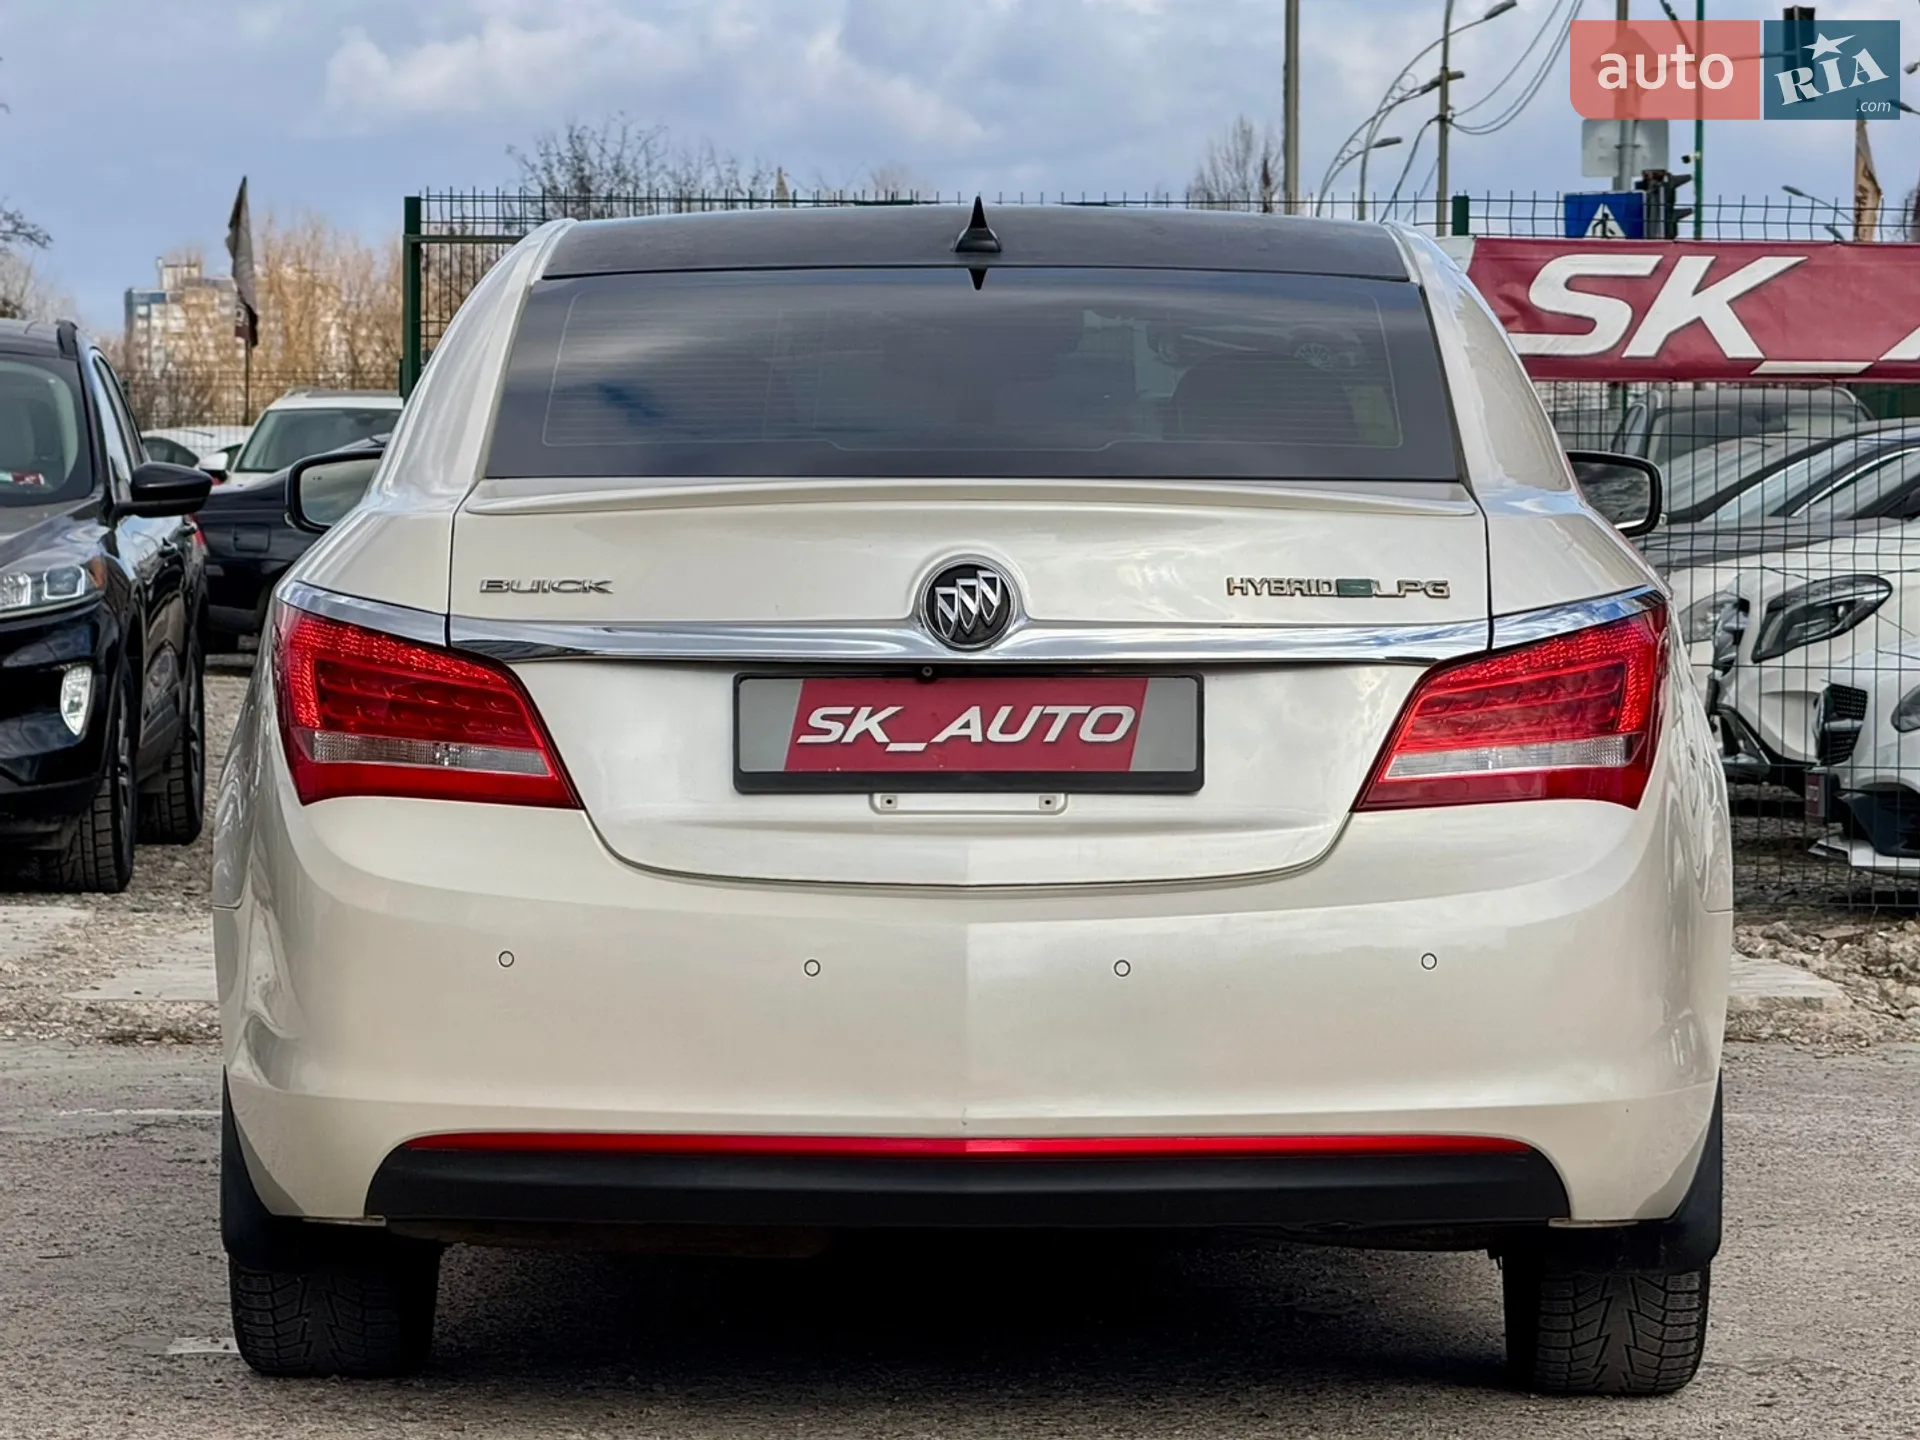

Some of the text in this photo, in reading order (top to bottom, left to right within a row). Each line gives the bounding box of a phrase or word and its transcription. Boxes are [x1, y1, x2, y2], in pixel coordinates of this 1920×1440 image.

[479, 578, 614, 595] BUICK
[1226, 576, 1450, 599] HYBRID LPG
[797, 705, 1136, 752] SK_AUTO
